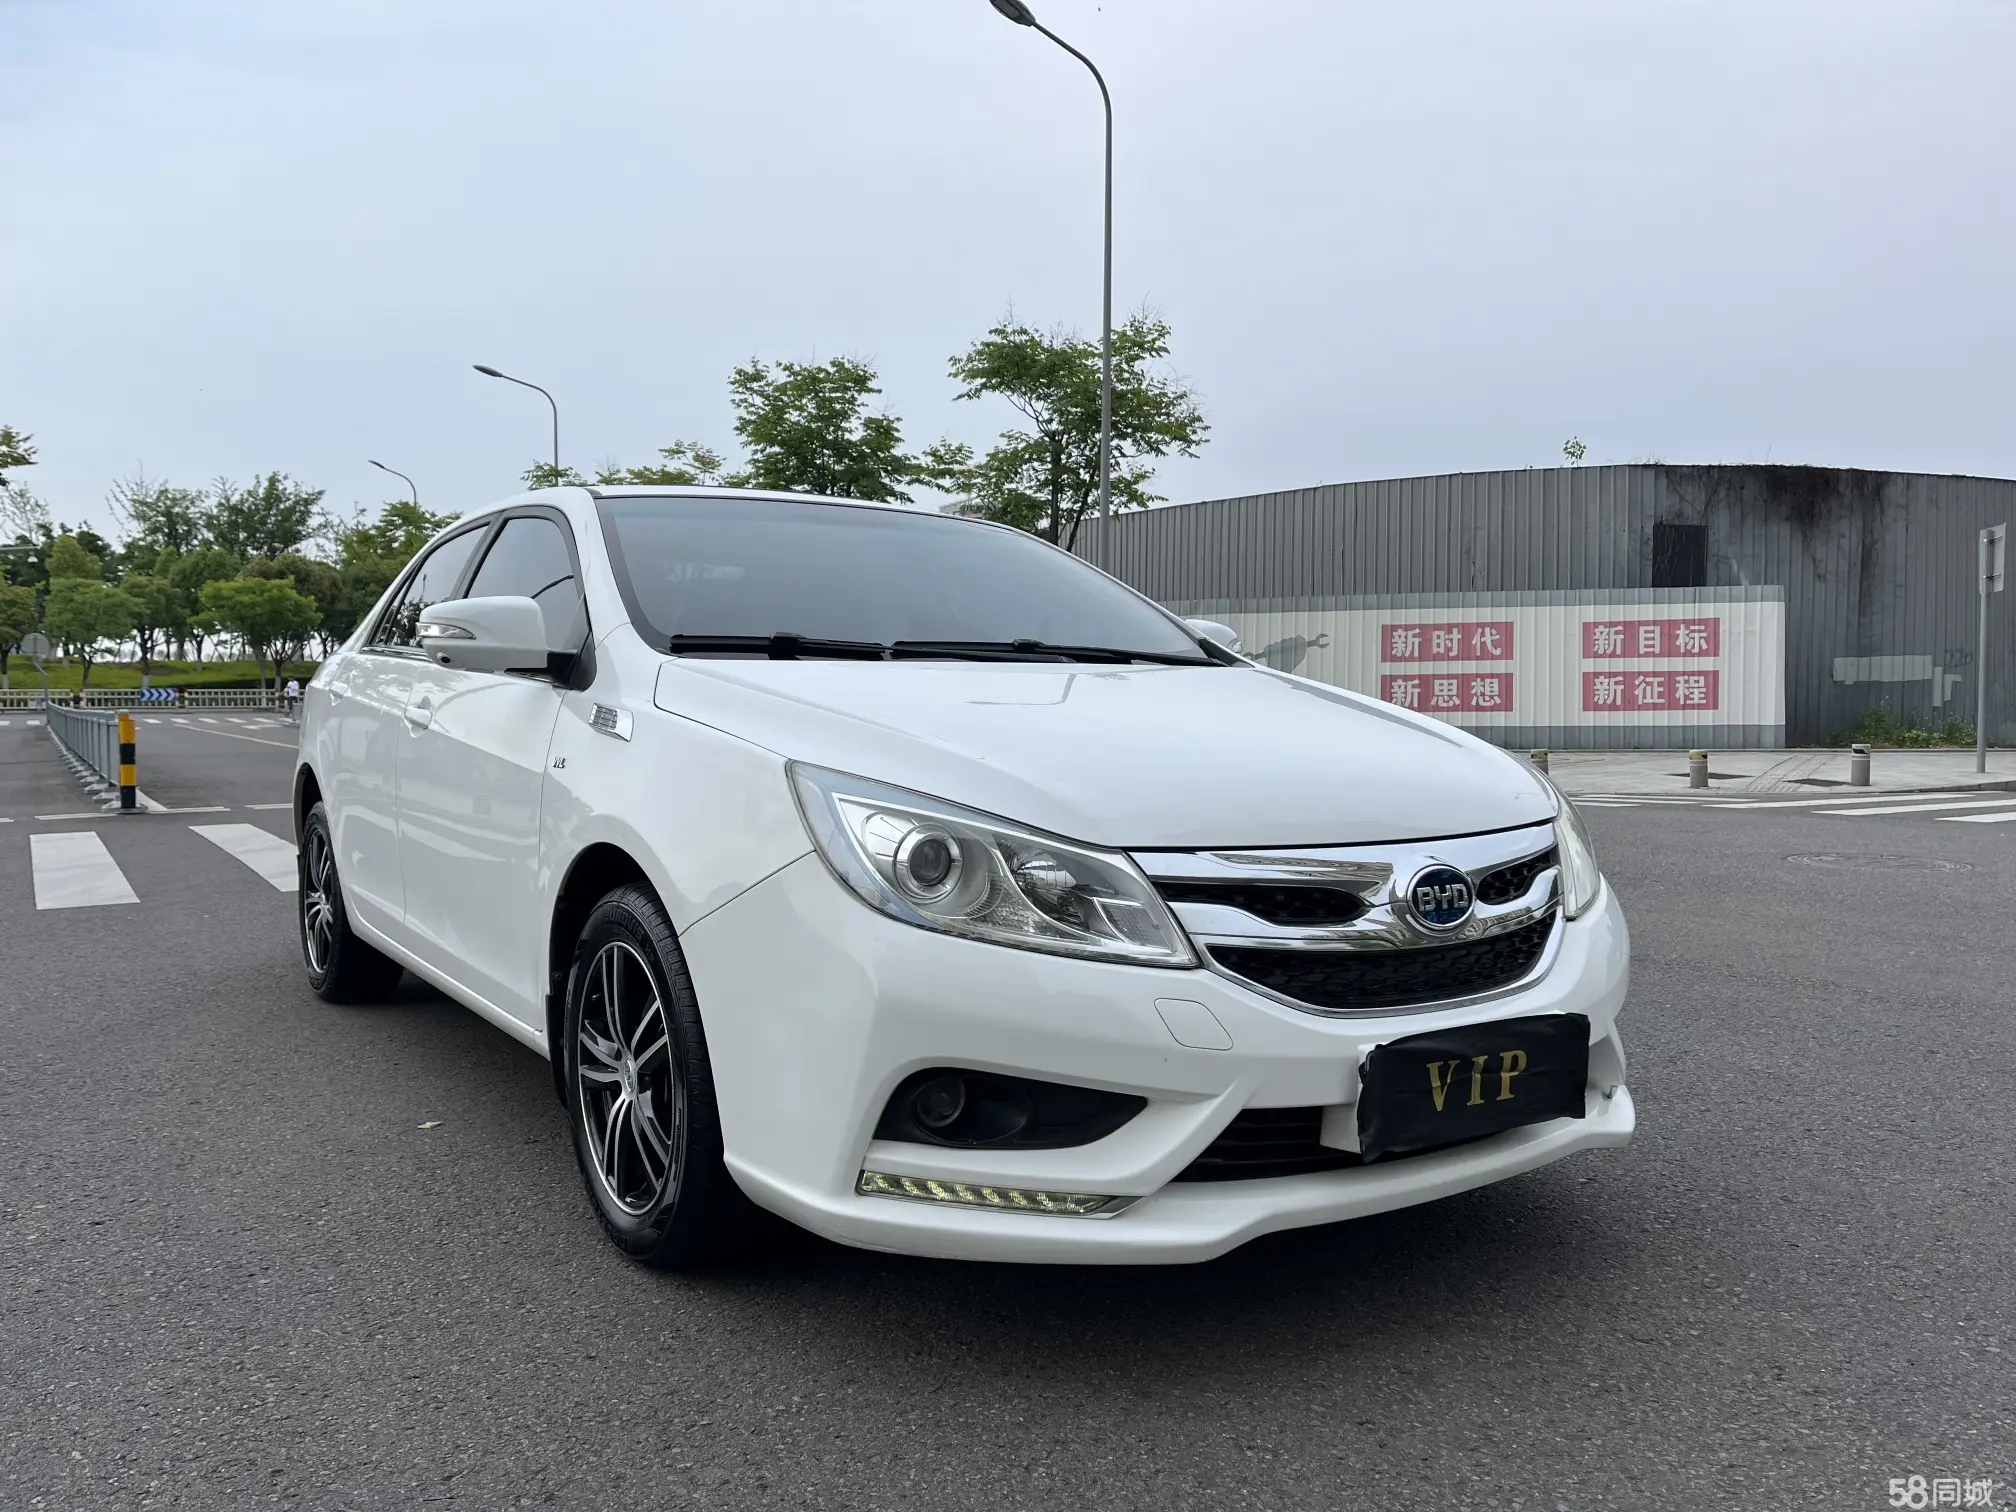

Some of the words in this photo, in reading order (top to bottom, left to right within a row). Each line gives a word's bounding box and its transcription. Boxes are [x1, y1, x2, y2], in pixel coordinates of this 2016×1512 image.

[1391, 627, 1502, 658] 新时代
[1592, 624, 1708, 655] 新目标
[1390, 677, 1502, 708] 新思想
[1592, 675, 1708, 706] 新征程
[1416, 883, 1469, 912] BYD
[1426, 1050, 1527, 1112] VIP
